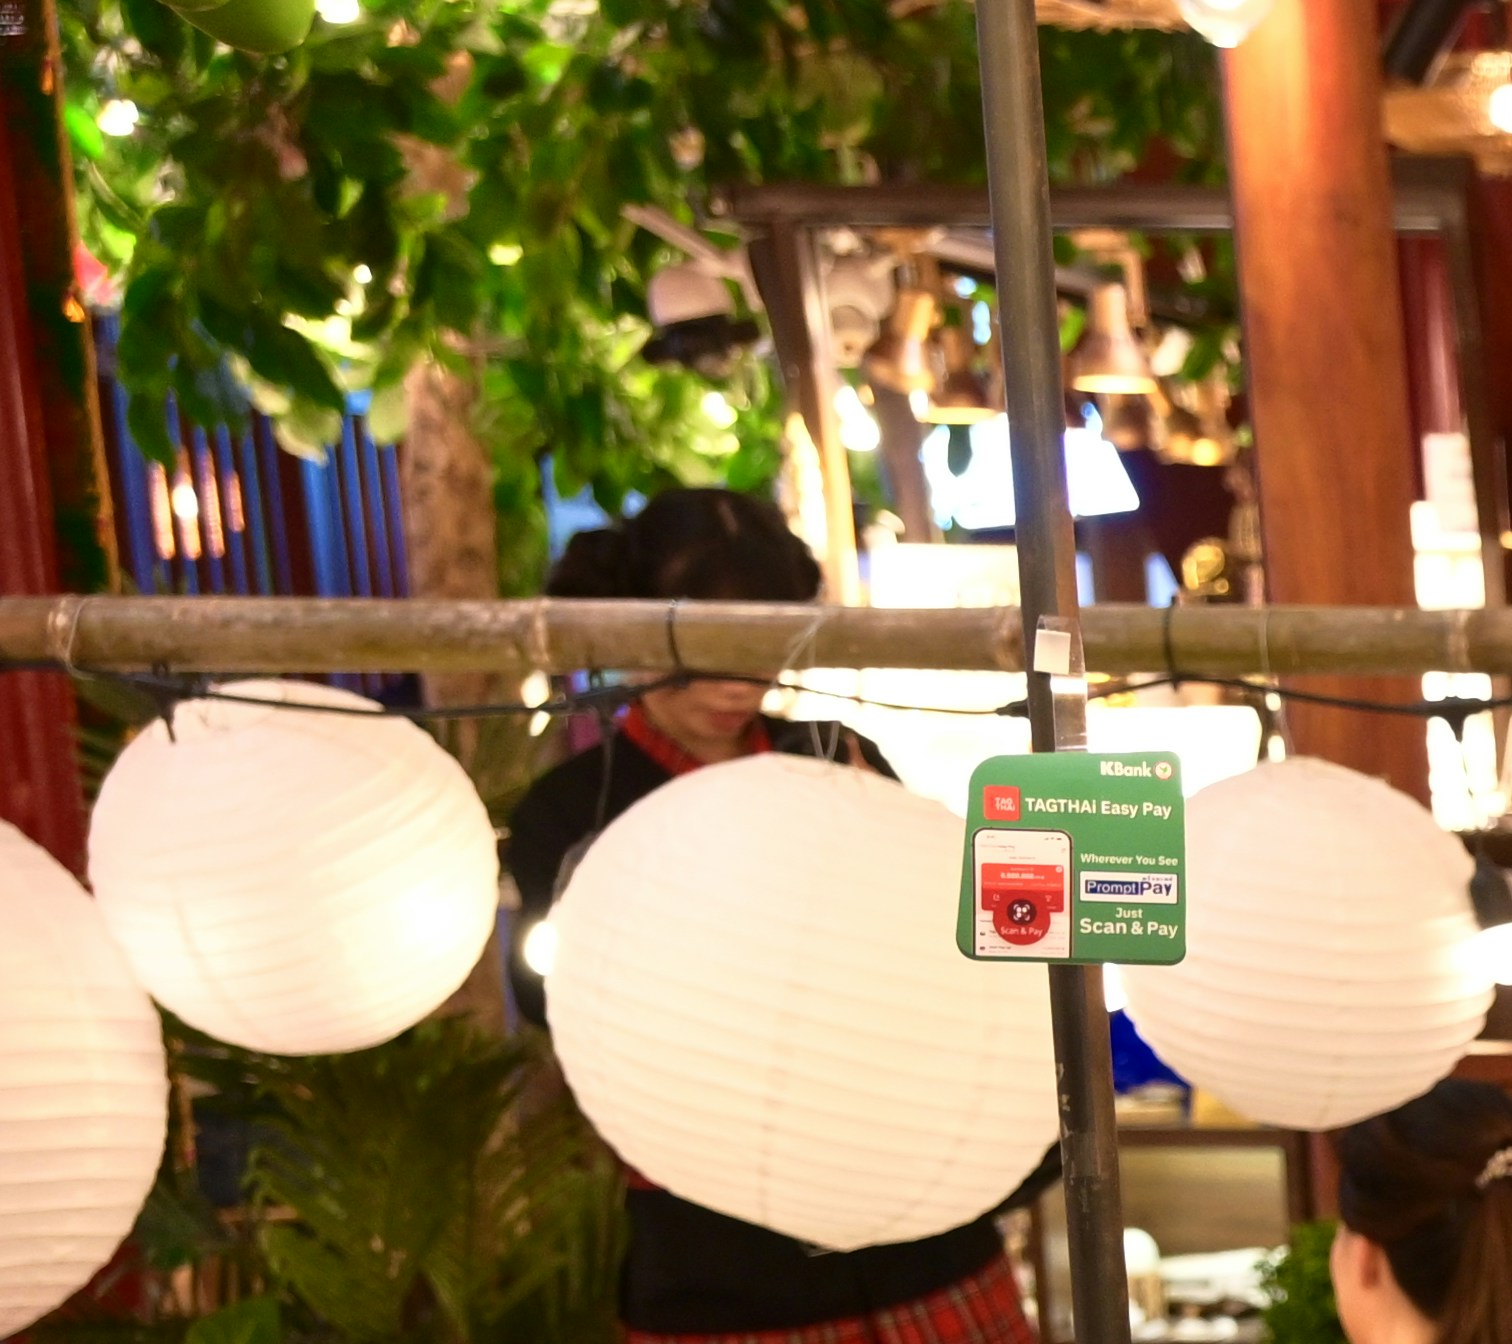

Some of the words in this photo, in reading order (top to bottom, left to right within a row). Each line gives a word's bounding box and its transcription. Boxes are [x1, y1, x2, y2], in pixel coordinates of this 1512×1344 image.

[1100, 761, 1152, 777] KBank
[1025, 798, 1097, 814] TAGTHAi
[1101, 801, 1139, 819] Easy
[1142, 803, 1172, 820] Pay
[1080, 853, 1133, 864] Wherever
[1135, 855, 1156, 865] You
[1158, 856, 1179, 866] See
[1115, 907, 1143, 919] Just
[1080, 917, 1127, 934] Scan
[1131, 921, 1144, 935] &
[1147, 921, 1179, 939] Pay
